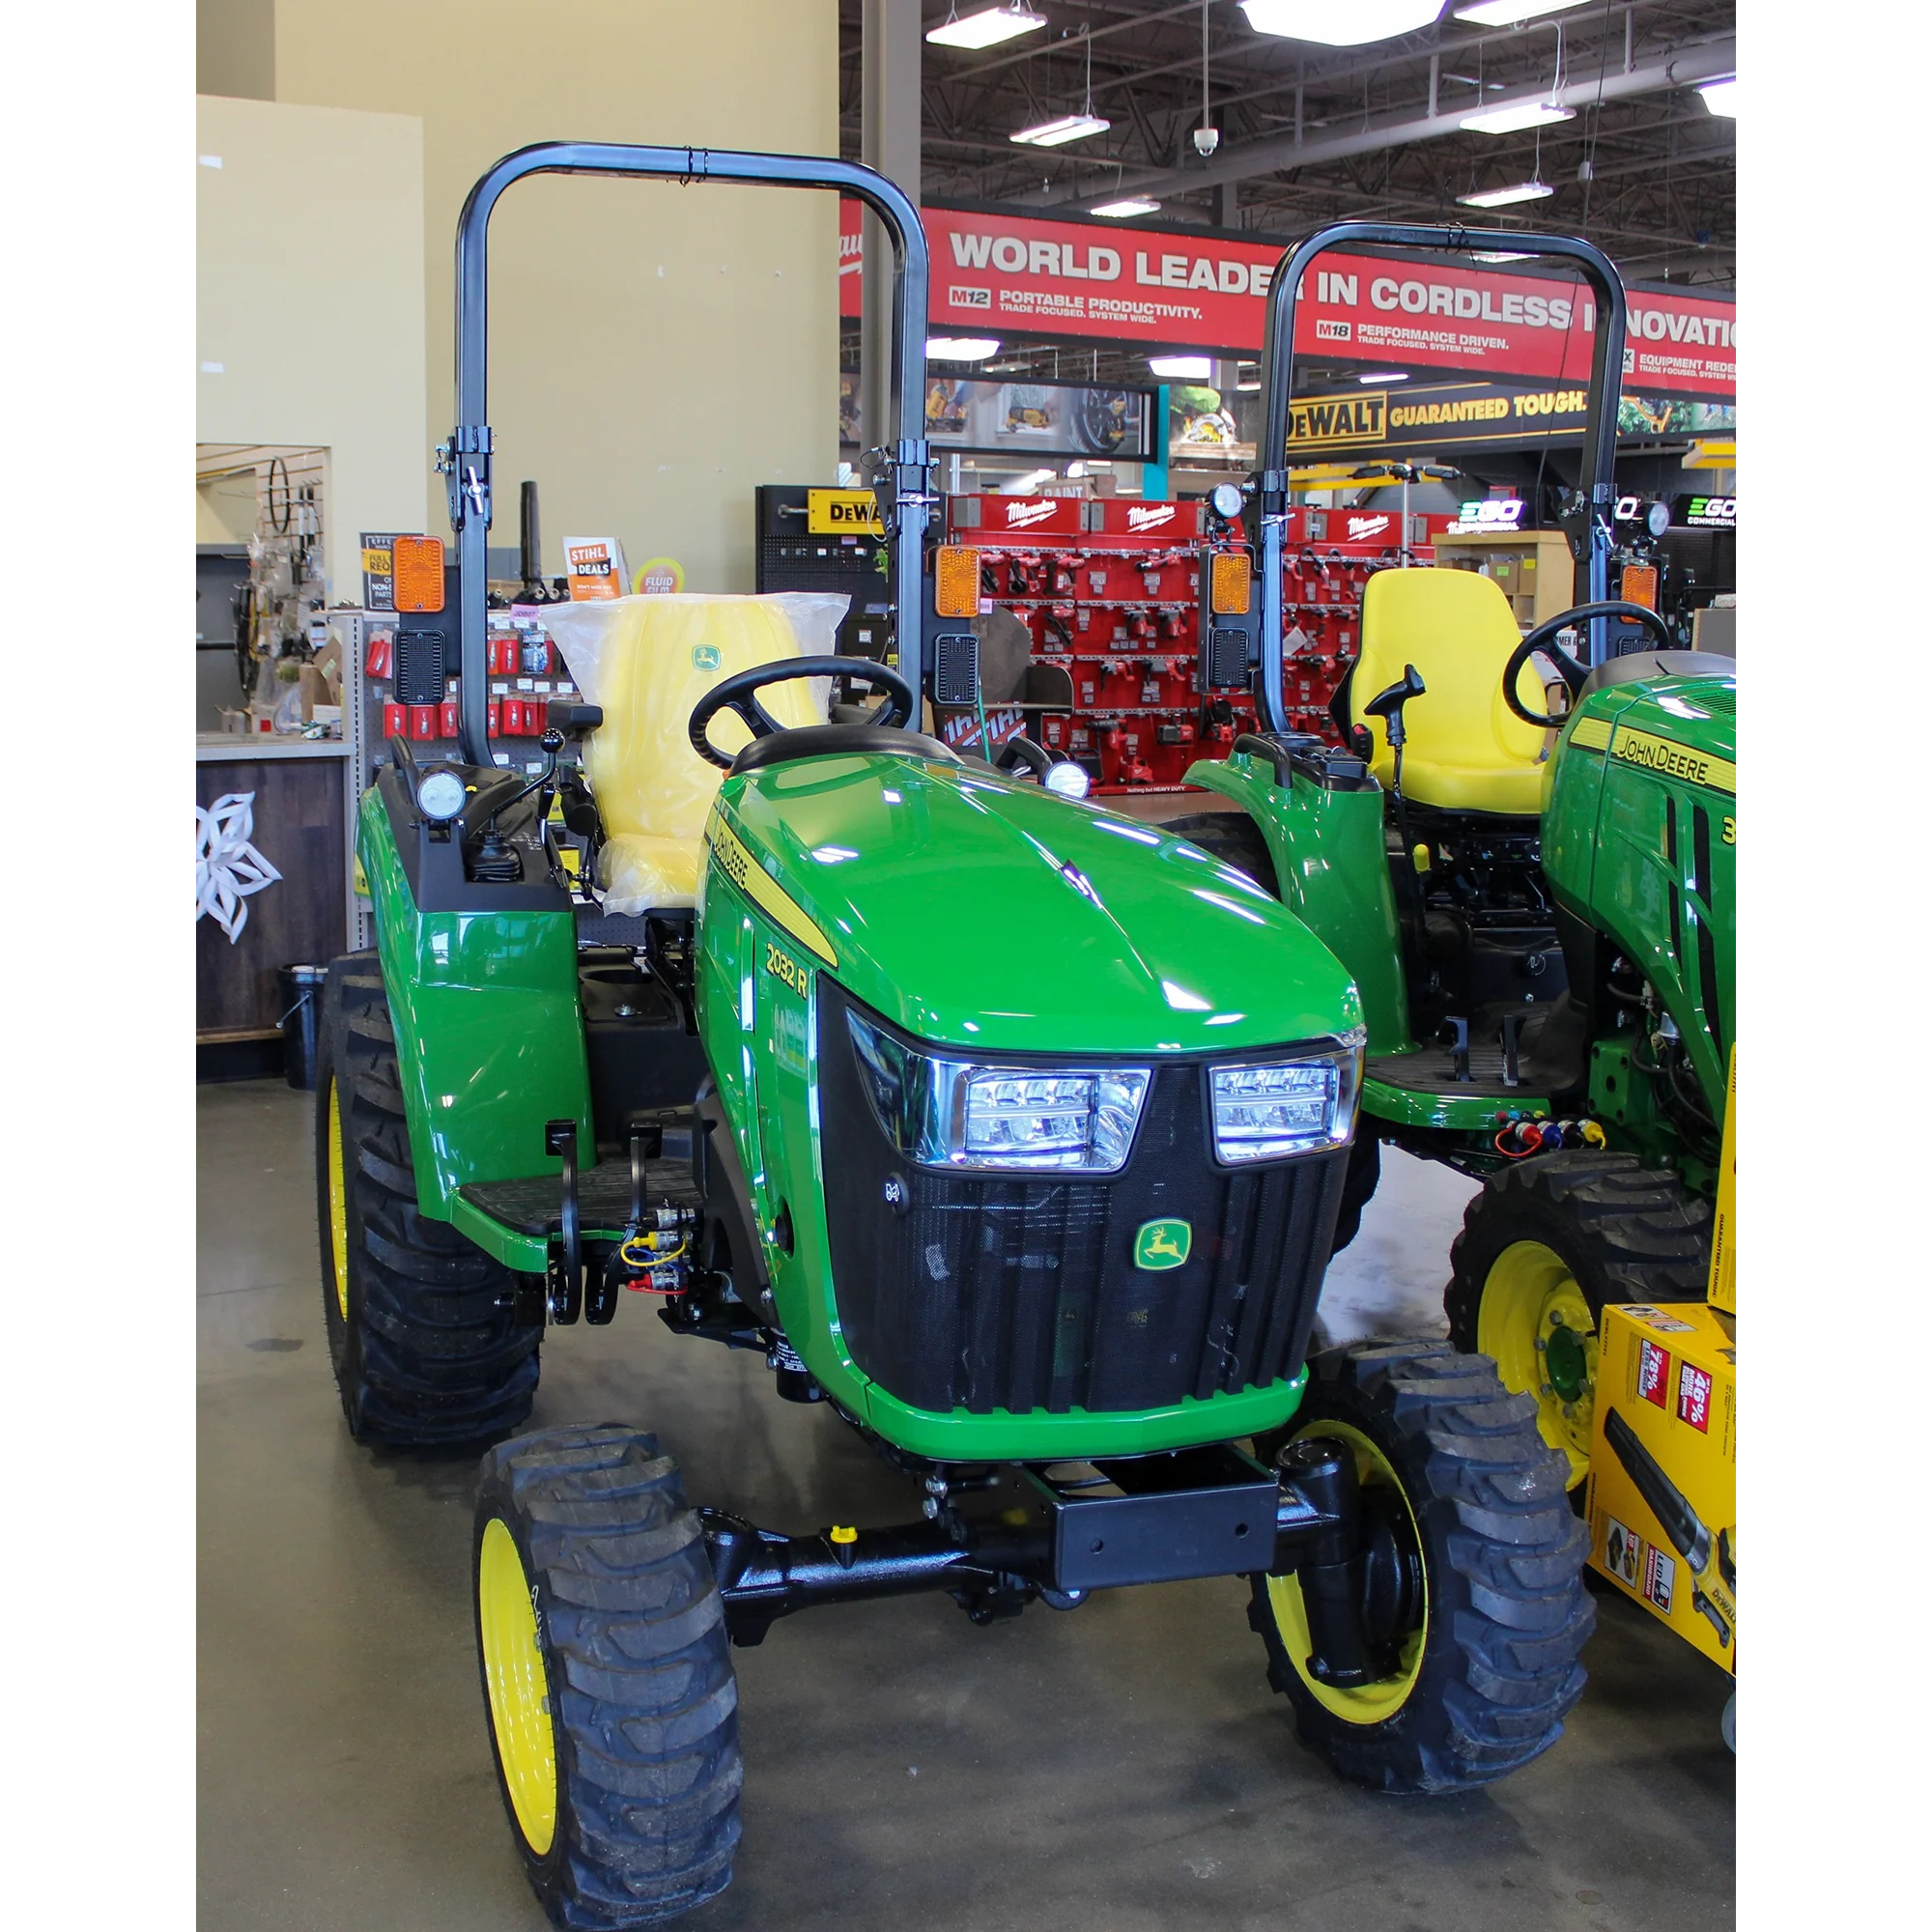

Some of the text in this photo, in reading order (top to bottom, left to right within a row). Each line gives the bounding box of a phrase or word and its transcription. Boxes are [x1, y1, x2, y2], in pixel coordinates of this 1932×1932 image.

[949, 232, 1122, 281] WORLD
[1318, 271, 1357, 306] IN
[1370, 279, 1573, 331] CORDLESS
[952, 290, 988, 305] M12
[1000, 290, 1203, 320] PORTABLE PRODUCTIVITY.
[999, 302, 1157, 325] TRADE FOCUSED. SYSTEM WIDE.
[1319, 324, 1350, 337] M18
[1357, 324, 1509, 350] PERFORMANCE DRIVEN.
[1357, 335, 1486, 355] TRADE FOCUSED. SYSTEM WIDE.
[1638, 364, 1662, 374] TRADE
[1699, 371, 1726, 381] SYSTEM
[1639, 354, 1704, 370] EQUIPMENT
[1705, 360, 1738, 374] REDE
[1390, 397, 1509, 428] GUARANTEED
[1006, 499, 1057, 523] Milwaukee
[1126, 504, 1176, 526] Milwaukee
[1687, 517, 1737, 526] COMMERCIAL
[571, 547, 605, 561] STIHL
[370, 562, 390, 571] REQ
[579, 564, 610, 575] DEALS
[644, 577, 673, 586] FLUID
[1620, 735, 1710, 782] JOHN DEERE
[766, 943, 795, 989] 2032
[1647, 1350, 1661, 1389] 78%
[1690, 1372, 1706, 1423] 46%
[1645, 1548, 1654, 1596] DASHBOARD
[1656, 1553, 1664, 1578] LED
